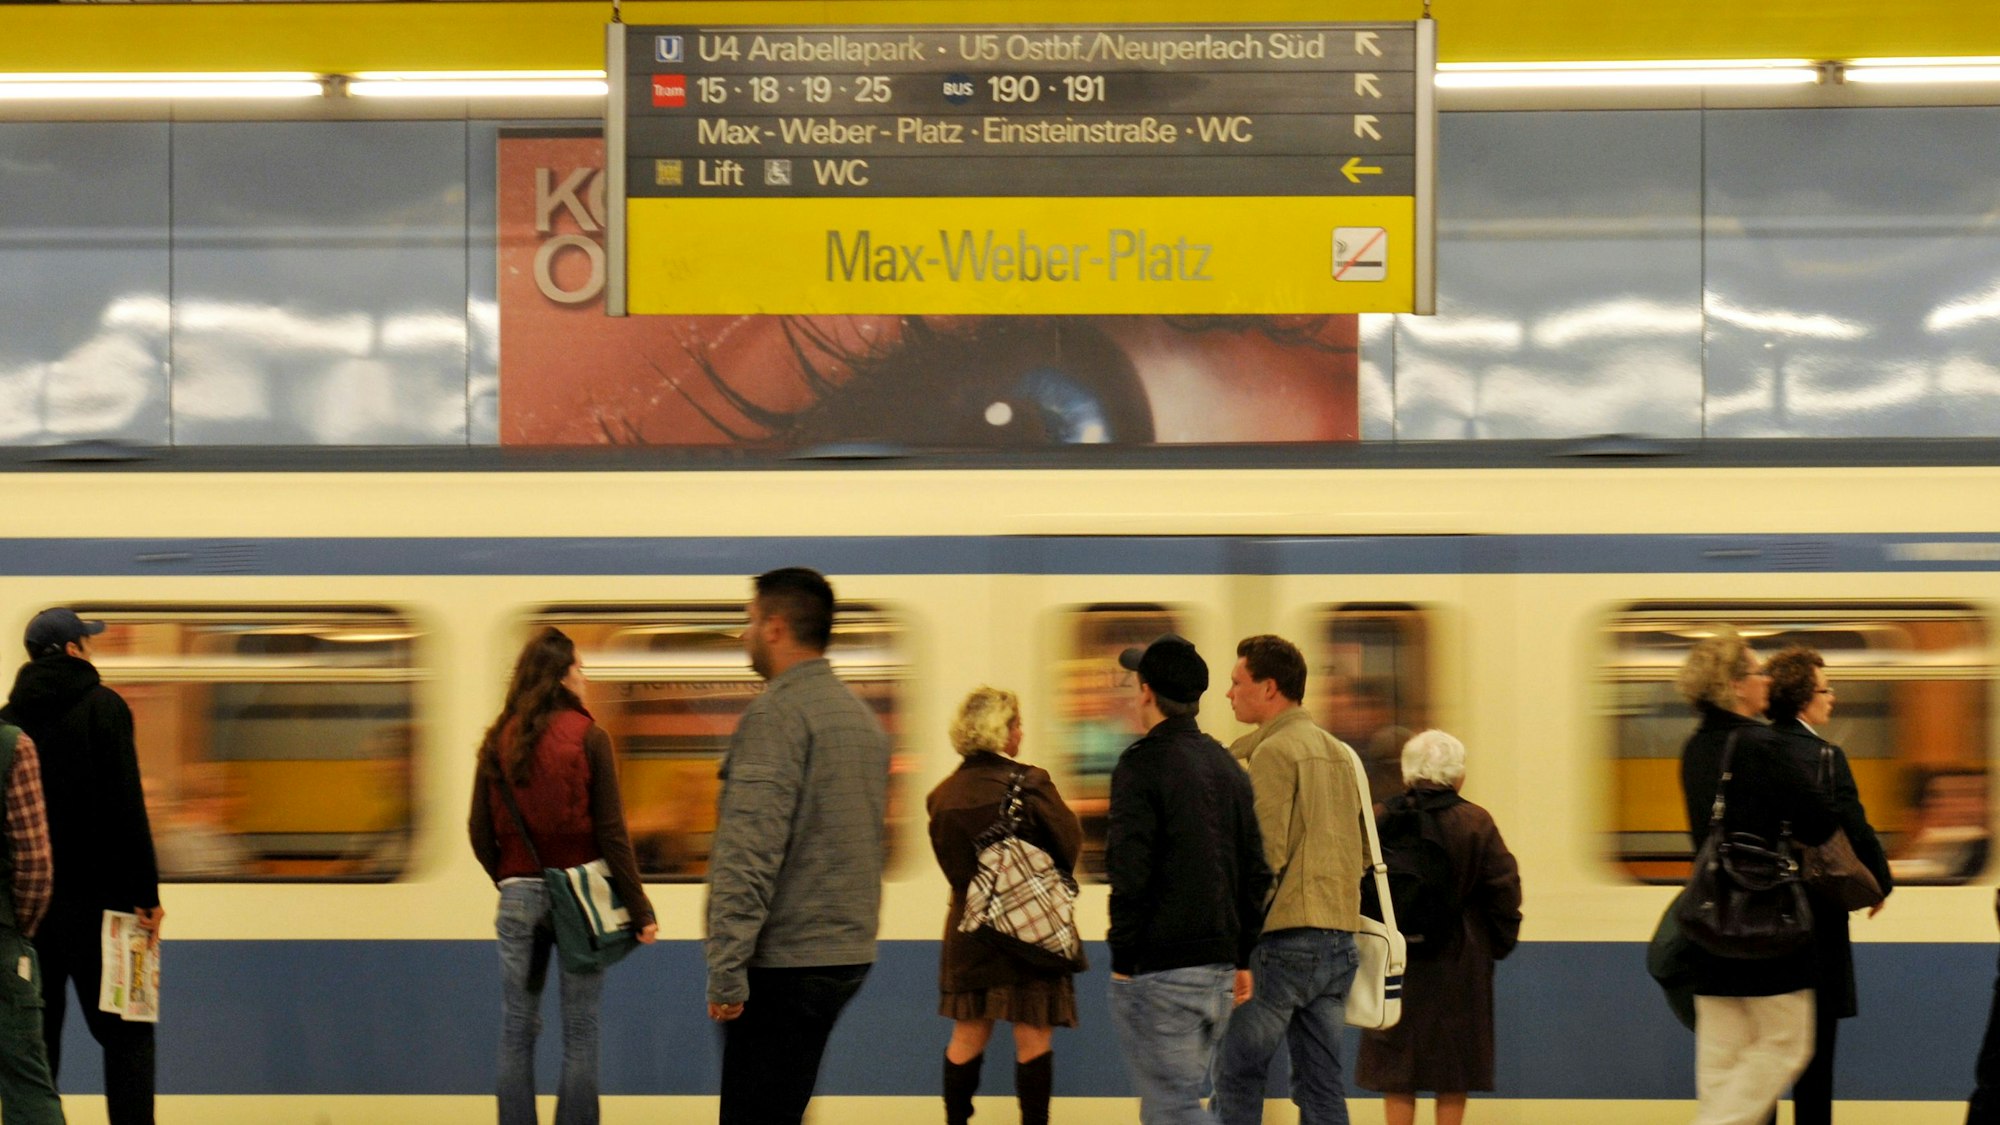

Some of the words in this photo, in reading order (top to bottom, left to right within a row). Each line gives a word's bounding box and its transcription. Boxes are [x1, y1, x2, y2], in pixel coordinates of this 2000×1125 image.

[660, 38, 678, 60] U
[699, 36, 741, 61] U4
[748, 35, 925, 66] Arabellapark
[959, 34, 999, 60] U5
[1268, 33, 1325, 60] Süd
[654, 84, 684, 96] Tram
[697, 77, 726, 103] 15
[749, 76, 779, 103] 18
[802, 76, 831, 102] 19
[855, 76, 891, 102] 25
[943, 83, 973, 96] BUS
[988, 76, 1039, 102] 190
[1063, 75, 1104, 102] 191
[984, 117, 1177, 143] Einsteinstraße
[1197, 116, 1252, 142] WC
[699, 160, 744, 186] Lift
[813, 159, 868, 186] WC
[825, 229, 1213, 282] Max-Weber-Platz
